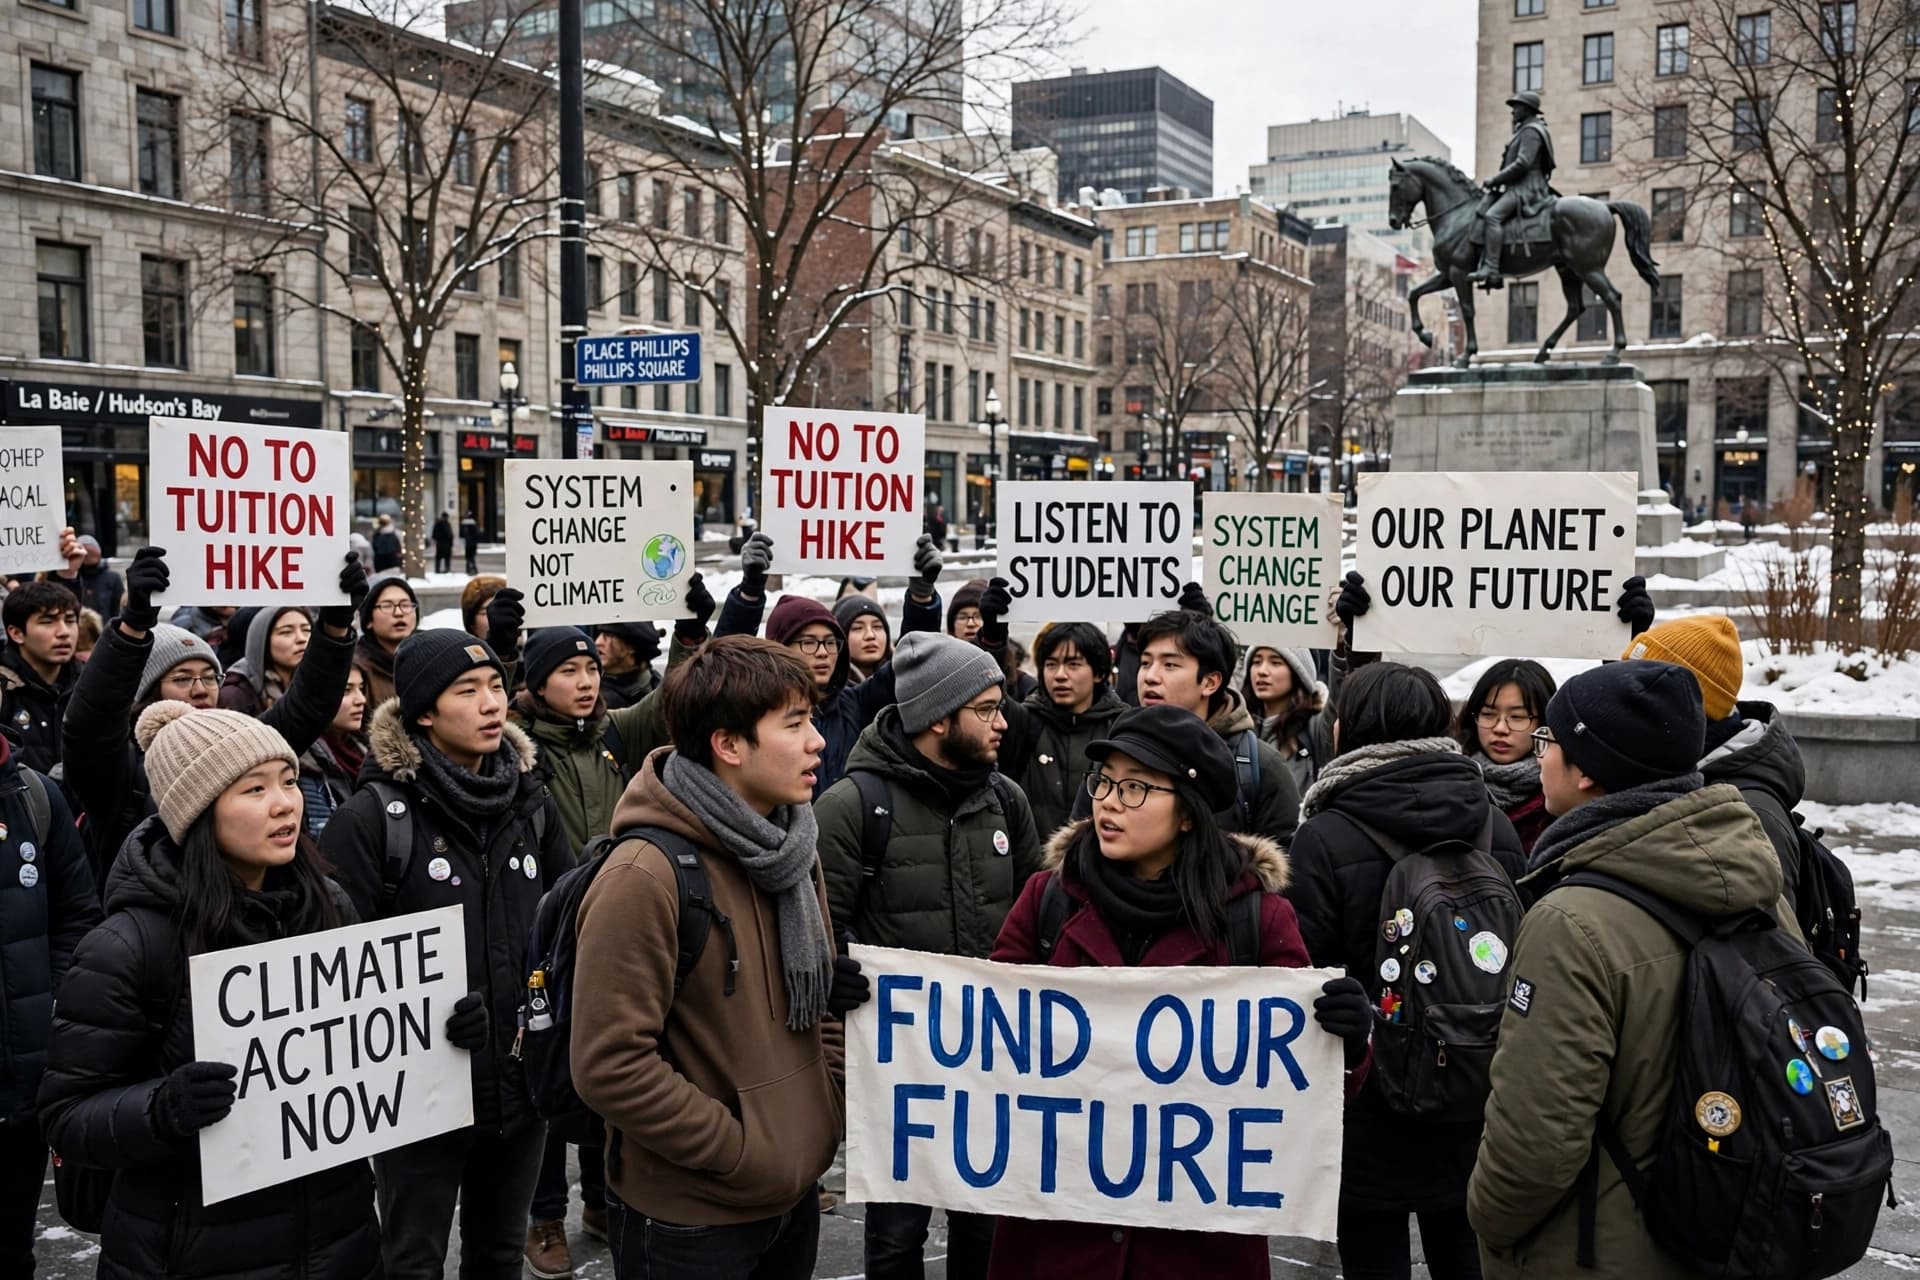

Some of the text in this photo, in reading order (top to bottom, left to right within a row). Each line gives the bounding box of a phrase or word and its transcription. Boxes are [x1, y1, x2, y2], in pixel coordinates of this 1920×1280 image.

[585, 339, 689, 360] PLACE PHILLIPS
[585, 360, 685, 379] PHILLIPS SQUARE
[20, 388, 41, 408] La
[49, 389, 89, 411] Baie
[110, 393, 187, 416] Hudson's
[192, 399, 221, 419] Bay
[189, 433, 316, 483] NO TO
[789, 421, 899, 464] NO TO
[525, 475, 642, 509] SYSTEM
[771, 469, 912, 512] TUITION
[167, 487, 333, 536] TUITION
[532, 516, 626, 545] CHANGE
[1015, 502, 1180, 543] LISTEN TO
[1213, 515, 1318, 549] SYSTEM
[1372, 507, 1444, 549] OUR
[1461, 508, 1605, 551] PLANET
[0, 527, 44, 546] TURE
[801, 519, 884, 560] HIKE
[206, 544, 303, 589] HIKE
[530, 553, 574, 577] NOT
[1009, 556, 1180, 598] STUDENTS
[1220, 555, 1322, 587] CHANGE
[533, 578, 625, 608] CLIMATE
[1215, 592, 1319, 625] CHANGE
[1382, 566, 1612, 612] OUR FUTURE
[218, 926, 443, 1028] CLIMATE
[238, 997, 431, 1100] ACTION
[878, 975, 1310, 1091] FUND OUR
[281, 1070, 405, 1160] NOW
[893, 1084, 1285, 1208] FUTURE
